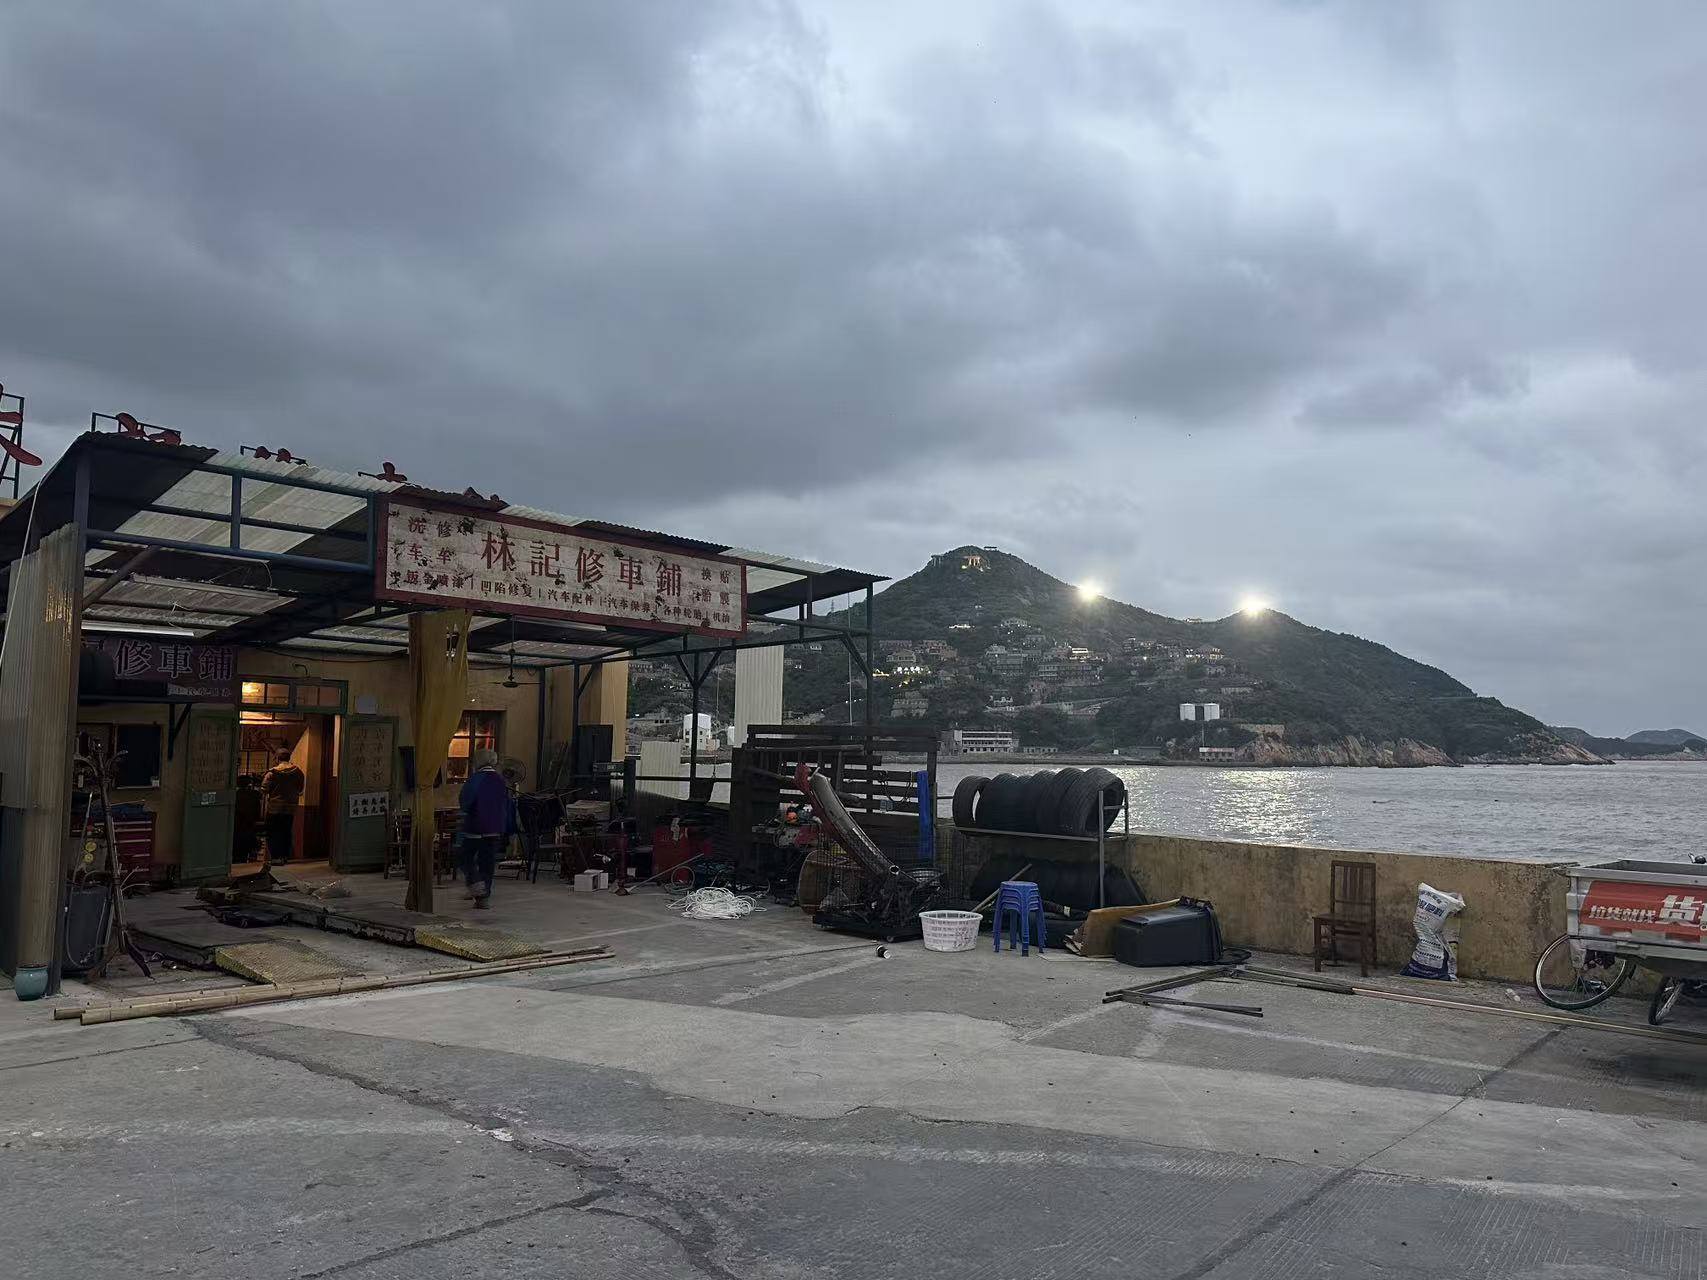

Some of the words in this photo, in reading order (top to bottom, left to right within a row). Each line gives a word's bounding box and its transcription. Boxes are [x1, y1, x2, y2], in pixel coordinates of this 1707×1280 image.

[481, 530, 682, 598] 林記修車鋪
[481, 580, 532, 598] 凹陷修复
[547, 588, 594, 607] 汽车配件
